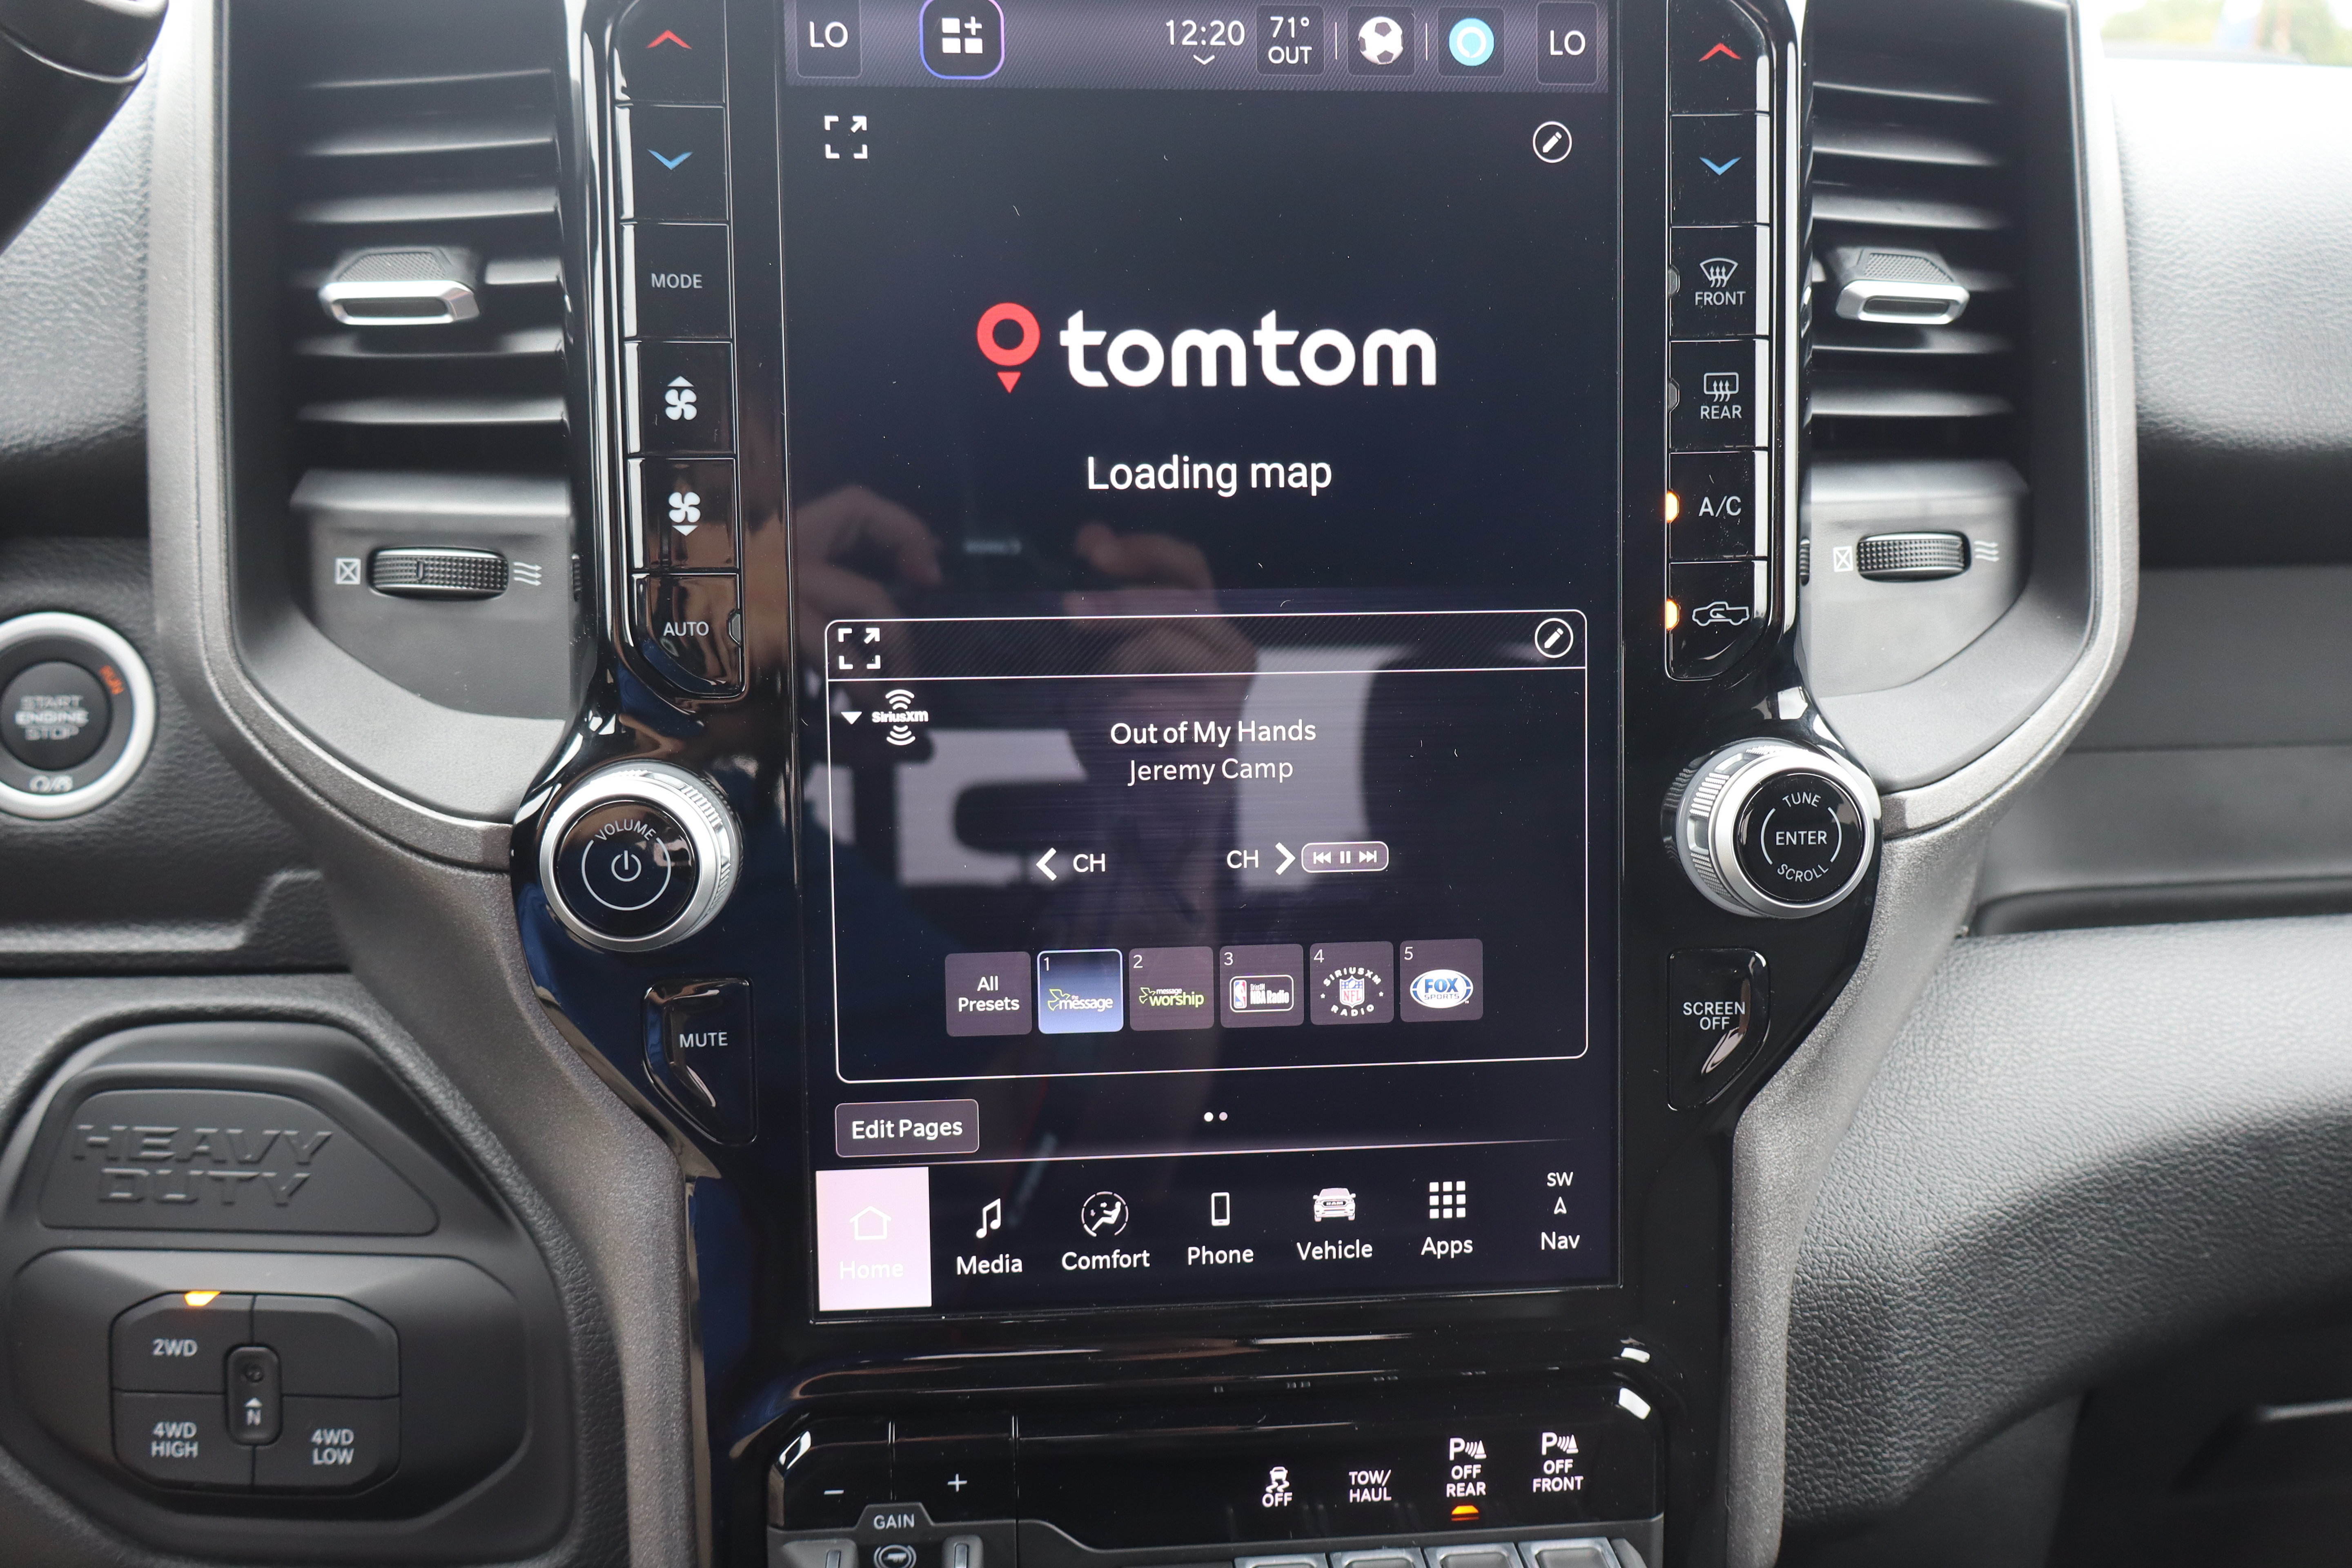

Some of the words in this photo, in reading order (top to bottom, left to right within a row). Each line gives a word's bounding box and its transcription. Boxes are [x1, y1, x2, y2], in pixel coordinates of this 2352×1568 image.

[809, 21, 848, 48] LO
[1166, 19, 1245, 46] 12:20
[1550, 30, 1586, 56] LO
[1268, 46, 1312, 64] OUT
[651, 273, 702, 288] MODE
[1695, 291, 1746, 305] FRONT
[1059, 310, 1437, 387] tomtom
[1700, 405, 1742, 419] REAR
[1088, 454, 1237, 497] Loading
[1251, 462, 1332, 496] map
[1699, 496, 1741, 517] A/C
[663, 621, 709, 636] AUTO
[25, 726, 80, 740] STOP
[1111, 723, 1158, 744] Out
[1163, 721, 1188, 743] of
[1194, 721, 1231, 748] My
[1238, 719, 1316, 742] Hands
[1127, 760, 1216, 786] Jeremy
[1222, 758, 1293, 783] Camp
[1783, 791, 1821, 808] TUNE
[595, 819, 657, 841] VOLUME
[1776, 831, 1827, 845] ENTER
[1073, 853, 1105, 873] CH
[1227, 849, 1259, 869] CH
[1777, 863, 1829, 882] SCROLL
[1133, 954, 1143, 969] 2
[1224, 952, 1233, 966] 3
[1314, 949, 1324, 963] 4
[1404, 947, 1413, 960] 5
[1044, 957, 1049, 971] 1
[977, 976, 998, 991] All
[1323, 967, 1381, 987] SIRIUSXM
[1425, 978, 1458, 993] FOX
[1149, 991, 1205, 1008] worship
[1250, 991, 1266, 1004] NBA
[1267, 990, 1290, 1004] Radio
[1343, 990, 1361, 1002] NFL
[958, 997, 1020, 1012] Presets
[1059, 997, 1114, 1012] message
[1331, 1004, 1374, 1016] RADIO
[1683, 1002, 1745, 1016] SCREEN
[1699, 1016, 1730, 1030] OFF
[679, 1032, 728, 1048] MUTE
[852, 1119, 895, 1139] Edit
[899, 1119, 963, 1140] Pages
[74, 1125, 332, 1165] HEAVY
[98, 1168, 311, 1206] DUTY
[1547, 1172, 1573, 1187] SW
[1421, 1236, 1473, 1259] Apps
[1541, 1231, 1580, 1250] Nav
[1188, 1245, 1254, 1265] Phone
[1296, 1239, 1373, 1261] Vehicle
[957, 1254, 1022, 1275] Media
[1062, 1249, 1150, 1270] Comfort
[840, 1260, 904, 1280] Home
[153, 1339, 197, 1356] 2WD
[247, 1409, 261, 1425] N
[153, 1422, 196, 1439] 4WD
[312, 1429, 354, 1445] 4WD
[151, 1441, 198, 1457] HIGH
[313, 1448, 354, 1465] LOW
[1451, 1464, 1481, 1480] OFF
[1543, 1459, 1573, 1474] OFF
[1349, 1469, 1392, 1487] TOW/
[1533, 1476, 1584, 1492] FRONT
[1350, 1487, 1392, 1503] HAUL
[1446, 1481, 1486, 1497] REAR
[1262, 1492, 1292, 1508] OFF
[873, 1514, 915, 1530] GAIN
